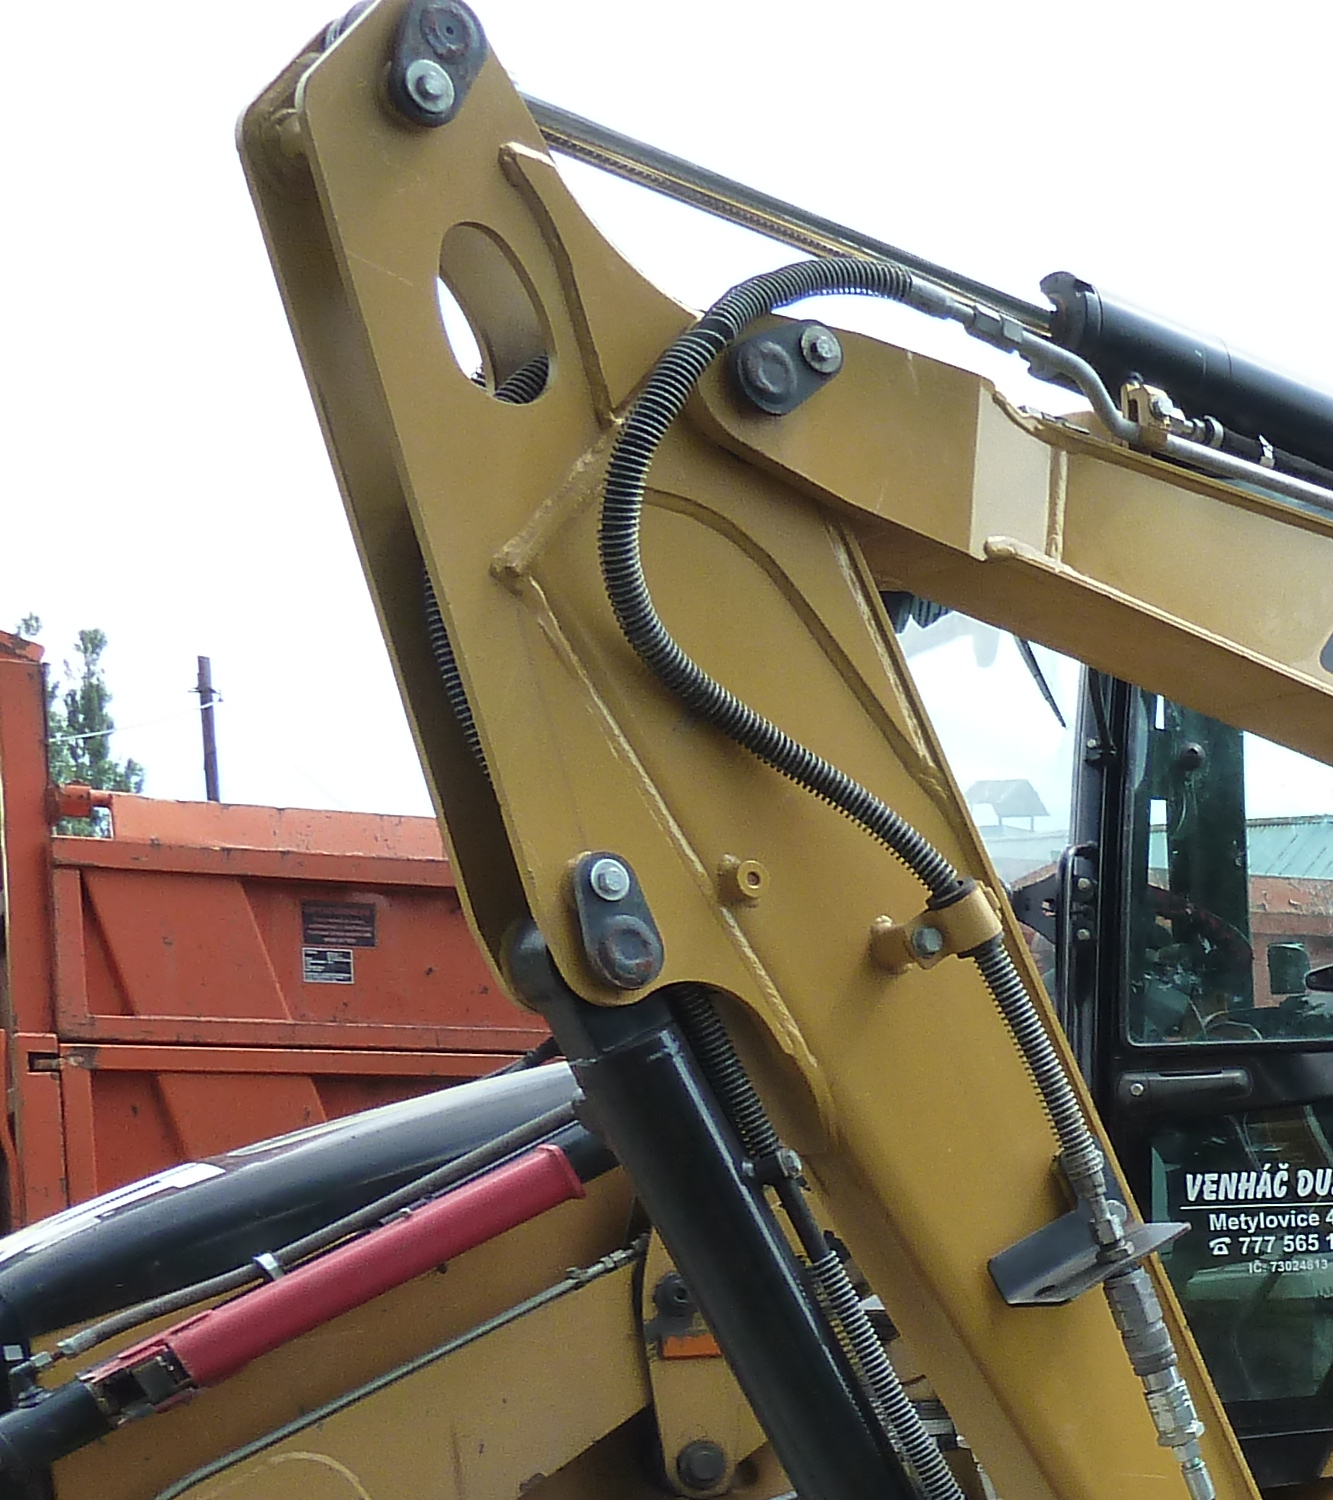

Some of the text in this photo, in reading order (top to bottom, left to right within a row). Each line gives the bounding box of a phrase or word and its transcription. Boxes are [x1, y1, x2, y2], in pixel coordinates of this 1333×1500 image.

[1186, 1163, 1290, 1201] VENHÁČ
[1209, 1211, 1320, 1233] Metylovice
[1238, 1236, 1276, 1254] 777
[1283, 1234, 1319, 1252] 565
